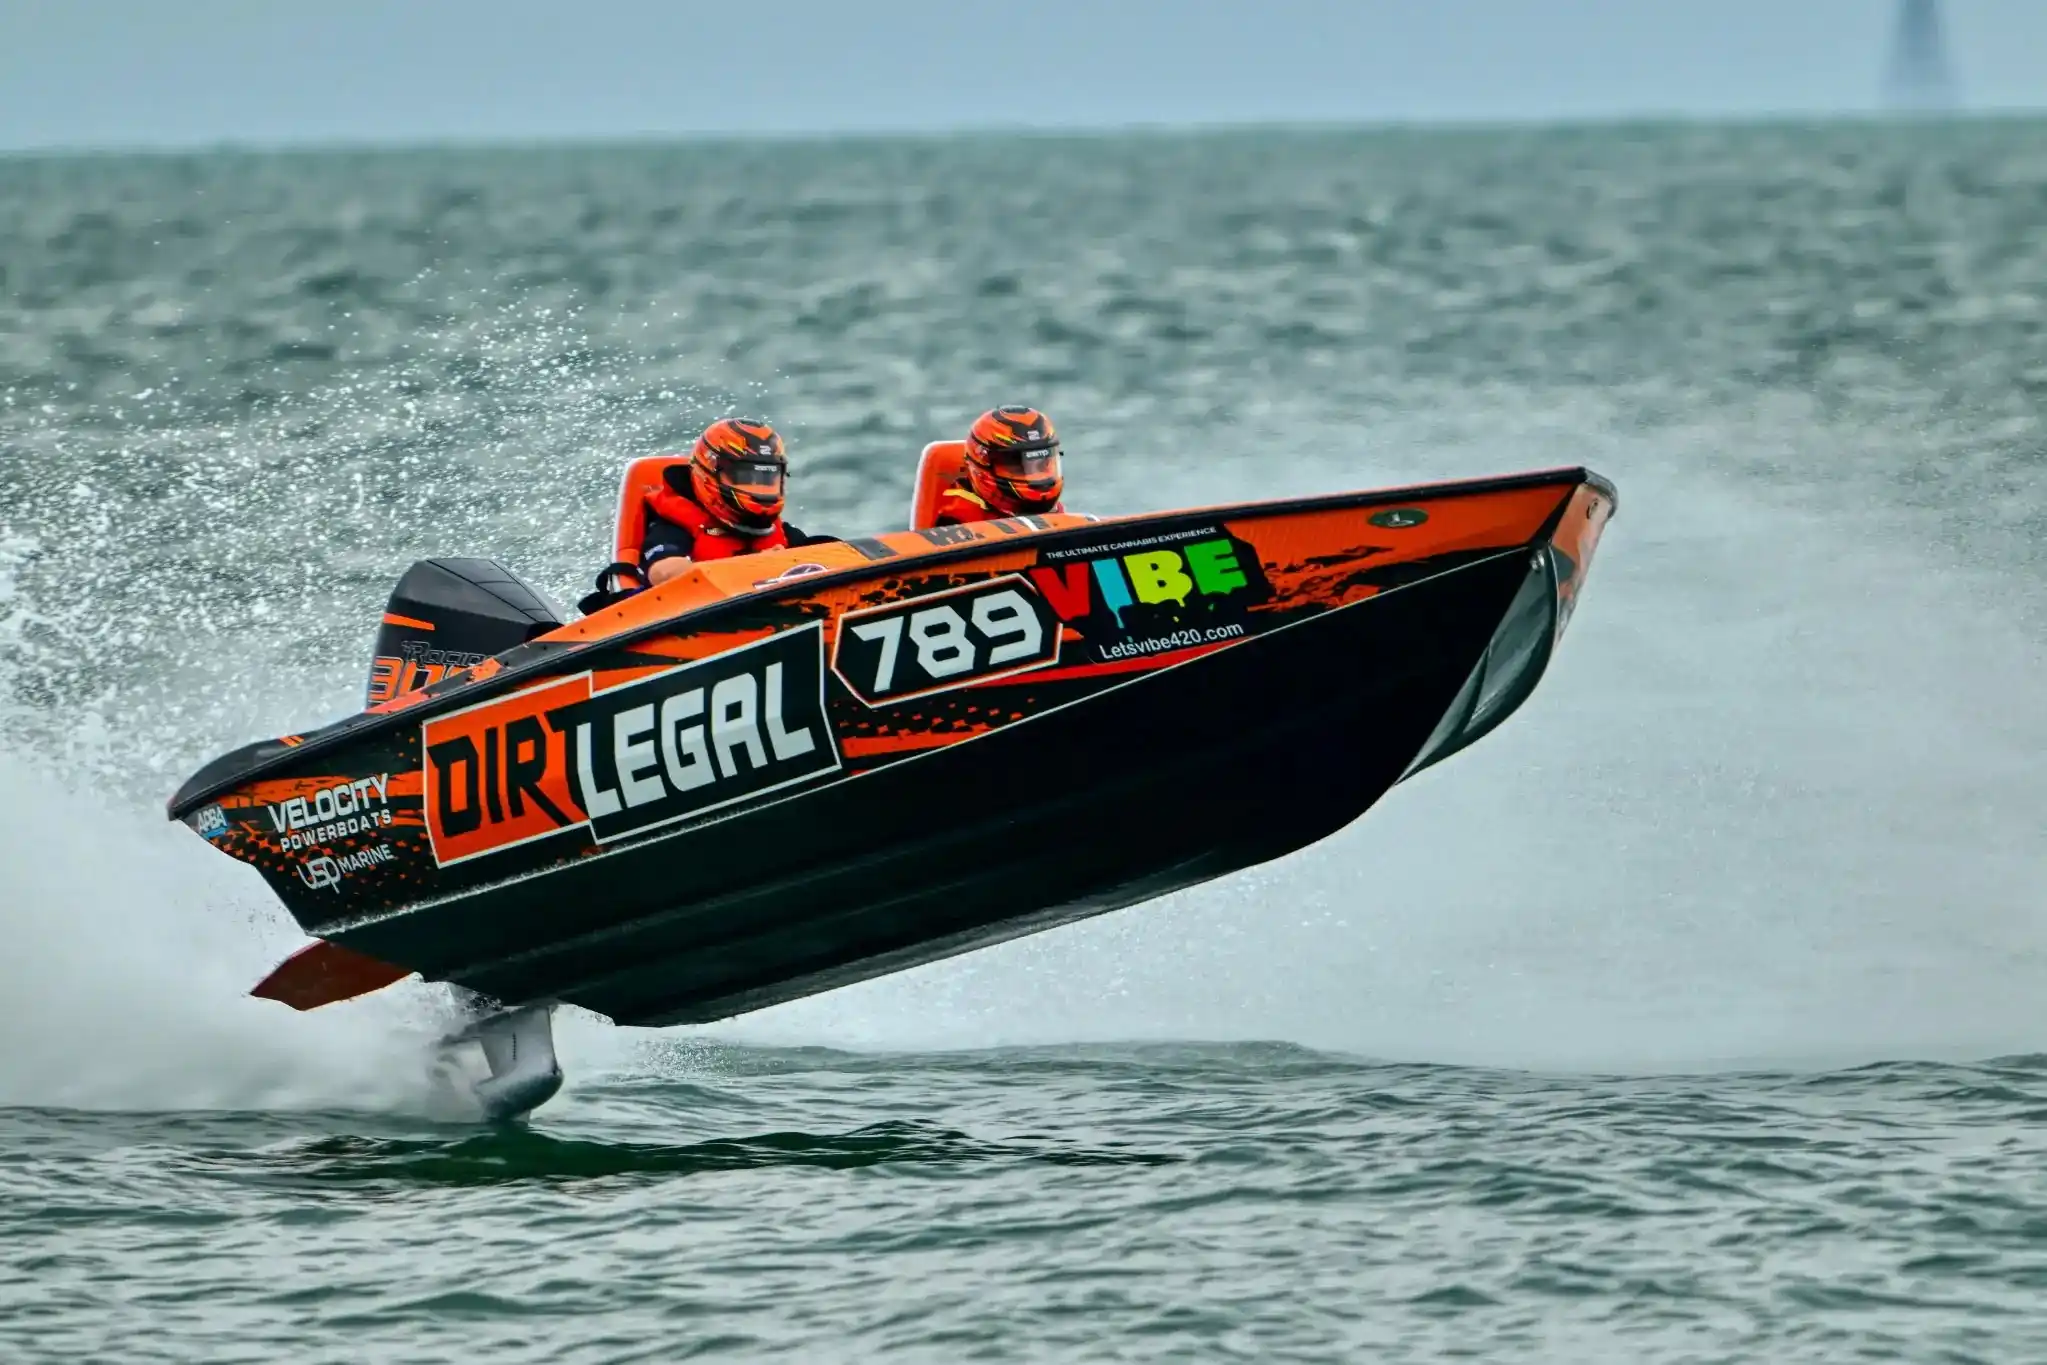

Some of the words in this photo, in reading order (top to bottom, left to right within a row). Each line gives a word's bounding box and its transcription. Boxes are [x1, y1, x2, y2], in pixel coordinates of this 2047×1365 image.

[1045, 551, 1065, 560] THE
[1066, 544, 1110, 558] ULTIMATE
[1110, 537, 1158, 551] CANNABIS
[1158, 526, 1217, 544] EXPERIENCE
[1028, 539, 1247, 628] VIBE
[850, 590, 1042, 692] 789
[576, 661, 816, 820] LEGAL
[267, 773, 388, 834] VELOCITY
[281, 809, 392, 852] POWERBOATS
[337, 843, 394, 874] MARINE
